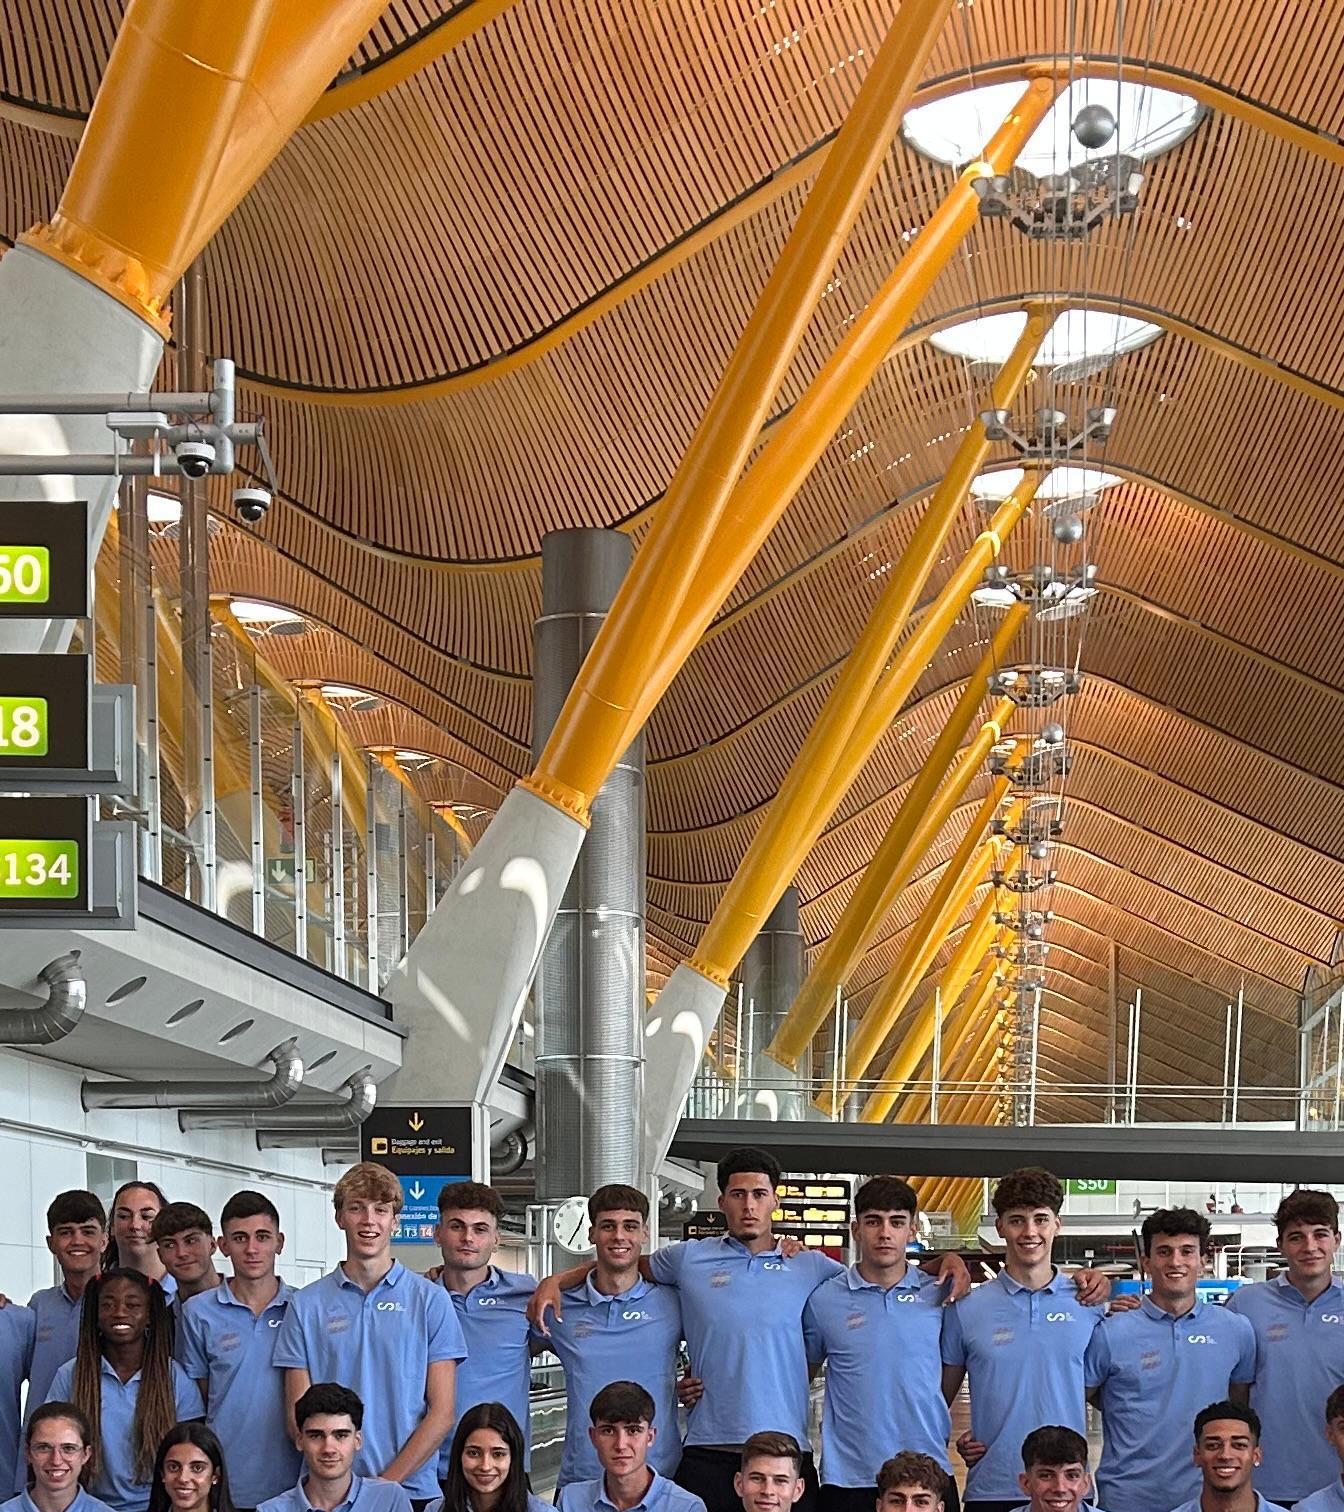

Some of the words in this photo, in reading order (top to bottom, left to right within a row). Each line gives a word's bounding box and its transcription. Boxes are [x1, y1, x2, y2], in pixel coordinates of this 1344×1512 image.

[391, 1146, 426, 1155] Equipajes
[434, 1146, 455, 1154] salida
[404, 1228, 418, 1237] T3
[420, 1228, 433, 1237] T4
